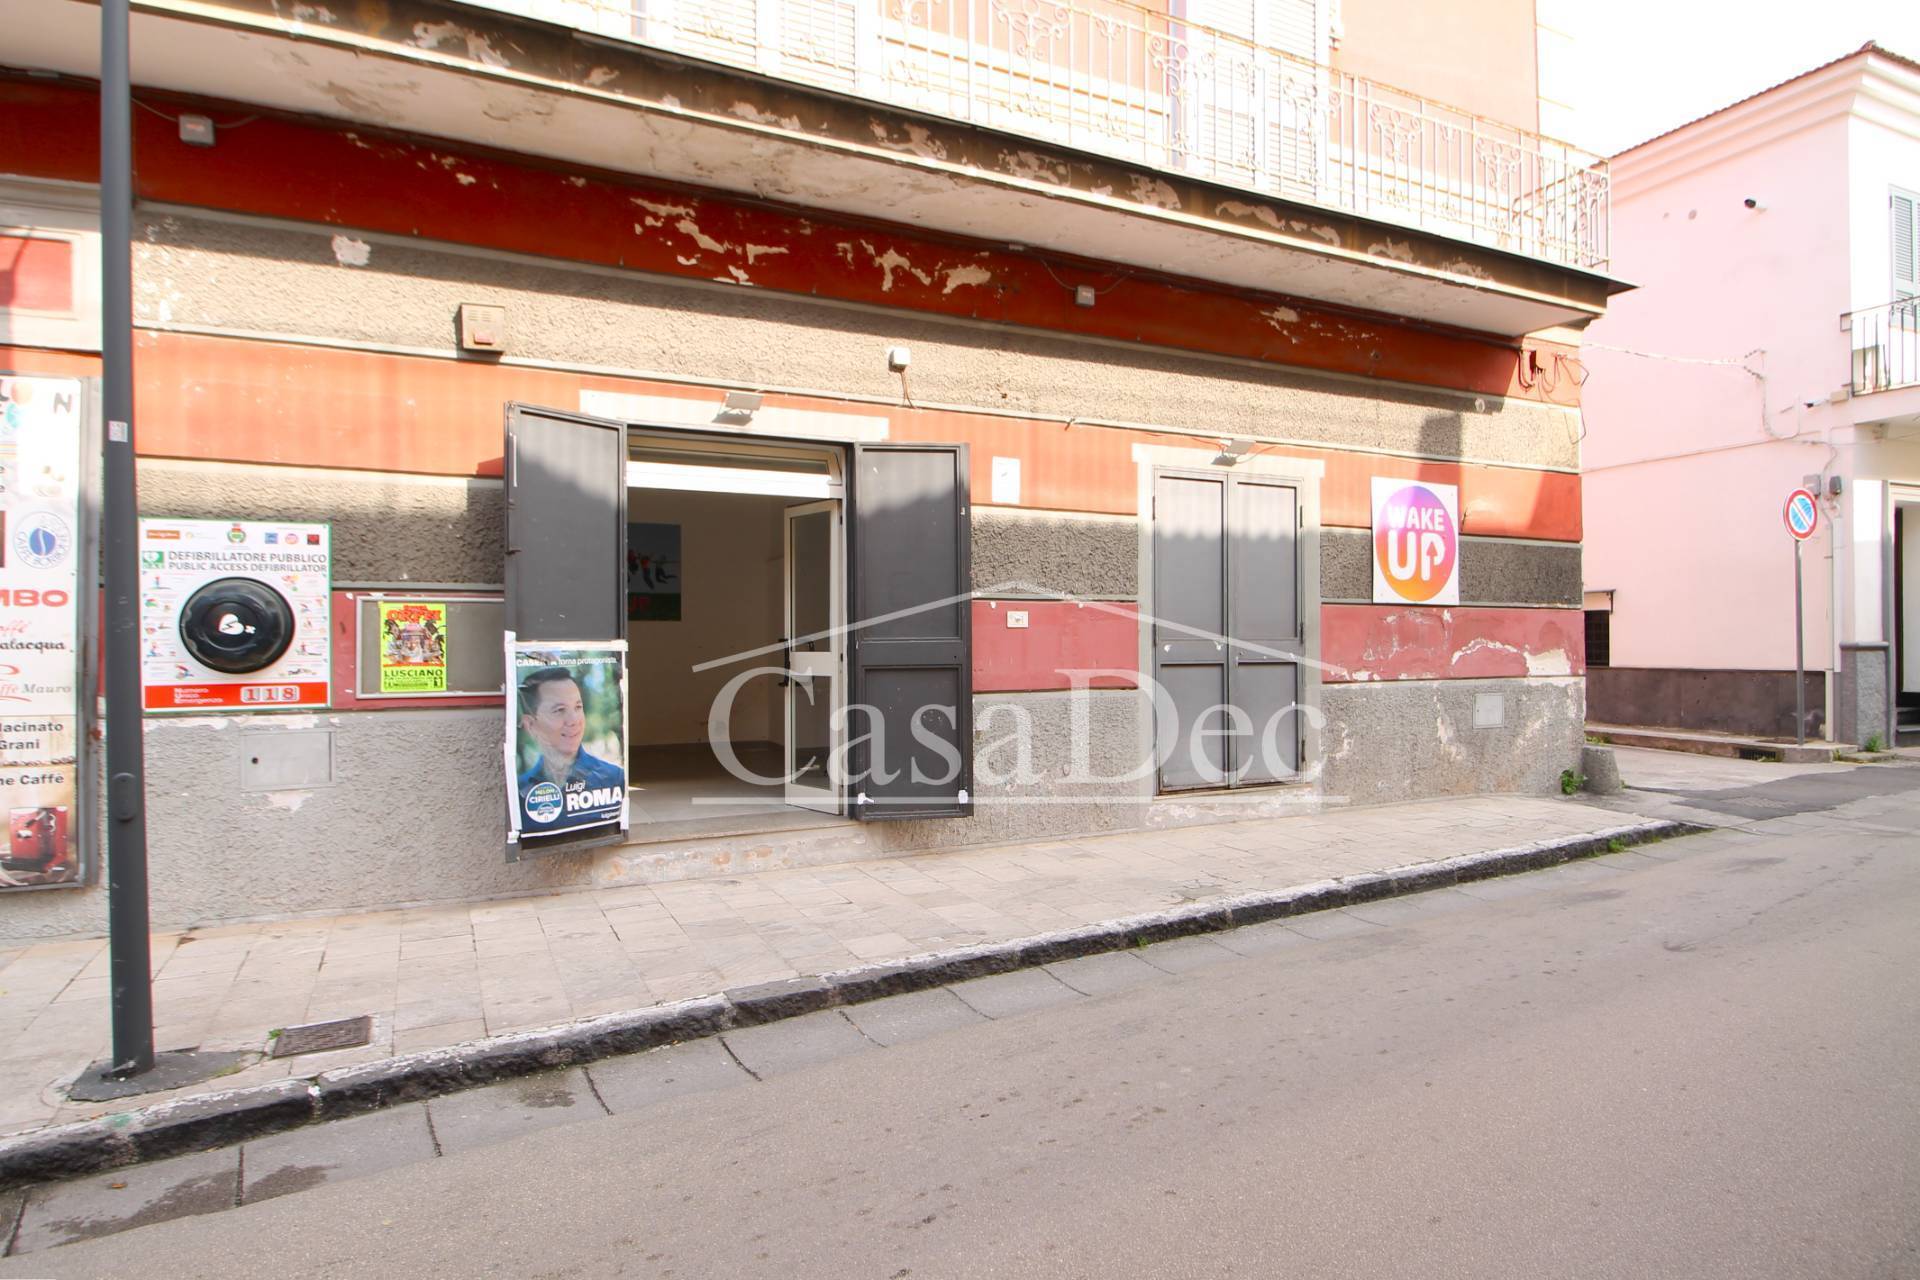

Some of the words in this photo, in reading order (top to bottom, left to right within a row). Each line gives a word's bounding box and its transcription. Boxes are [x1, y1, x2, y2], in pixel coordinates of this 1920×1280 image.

[1387, 506, 1445, 531] WAKE
[168, 550, 267, 562] DEFIBRILLATORE
[269, 553, 327, 563] PUBBLICO
[1388, 530, 1445, 581] UP
[168, 561, 208, 571] PUBLIC
[210, 562, 249, 571] ACCESS
[250, 563, 327, 573] DEFIBRILLATOR
[383, 669, 443, 677] LUSCIANO
[21, 683, 71, 694] Mauro
[247, 687, 294, 701] 118
[565, 780, 586, 793] Luigi
[566, 786, 623, 811] ROMA
